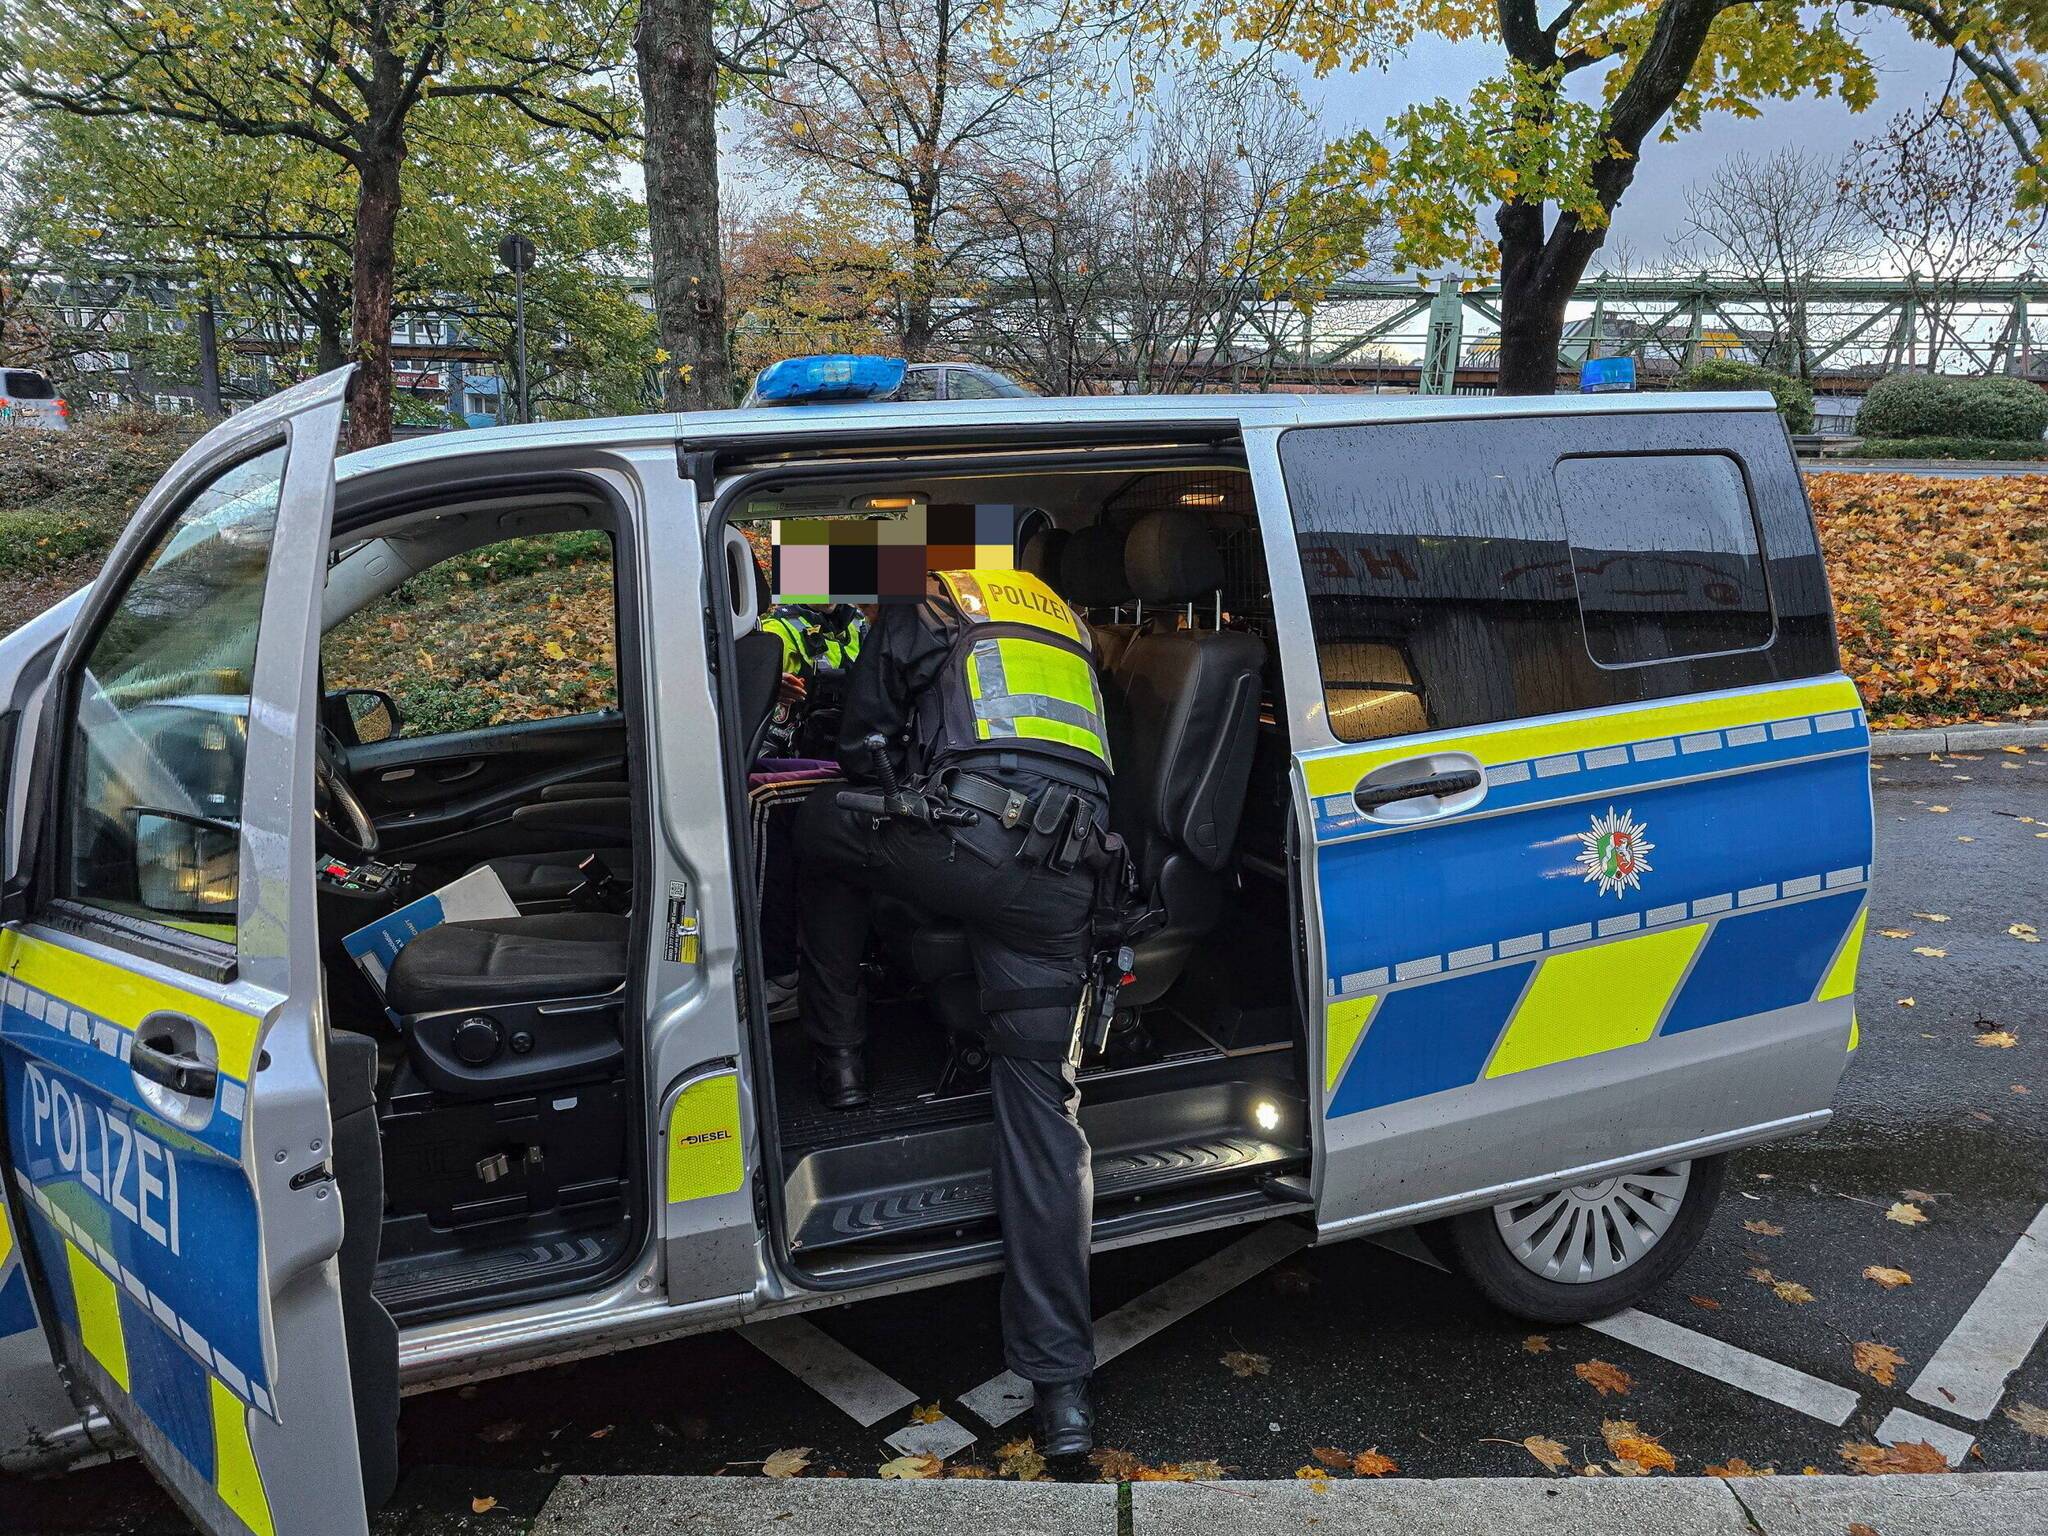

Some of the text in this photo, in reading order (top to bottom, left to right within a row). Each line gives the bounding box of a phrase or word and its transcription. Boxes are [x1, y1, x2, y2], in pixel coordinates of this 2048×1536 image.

[987, 583, 1069, 625] POLIZEI
[689, 1129, 732, 1145] DIESEL
[25, 1061, 181, 1257] POLIZEI
